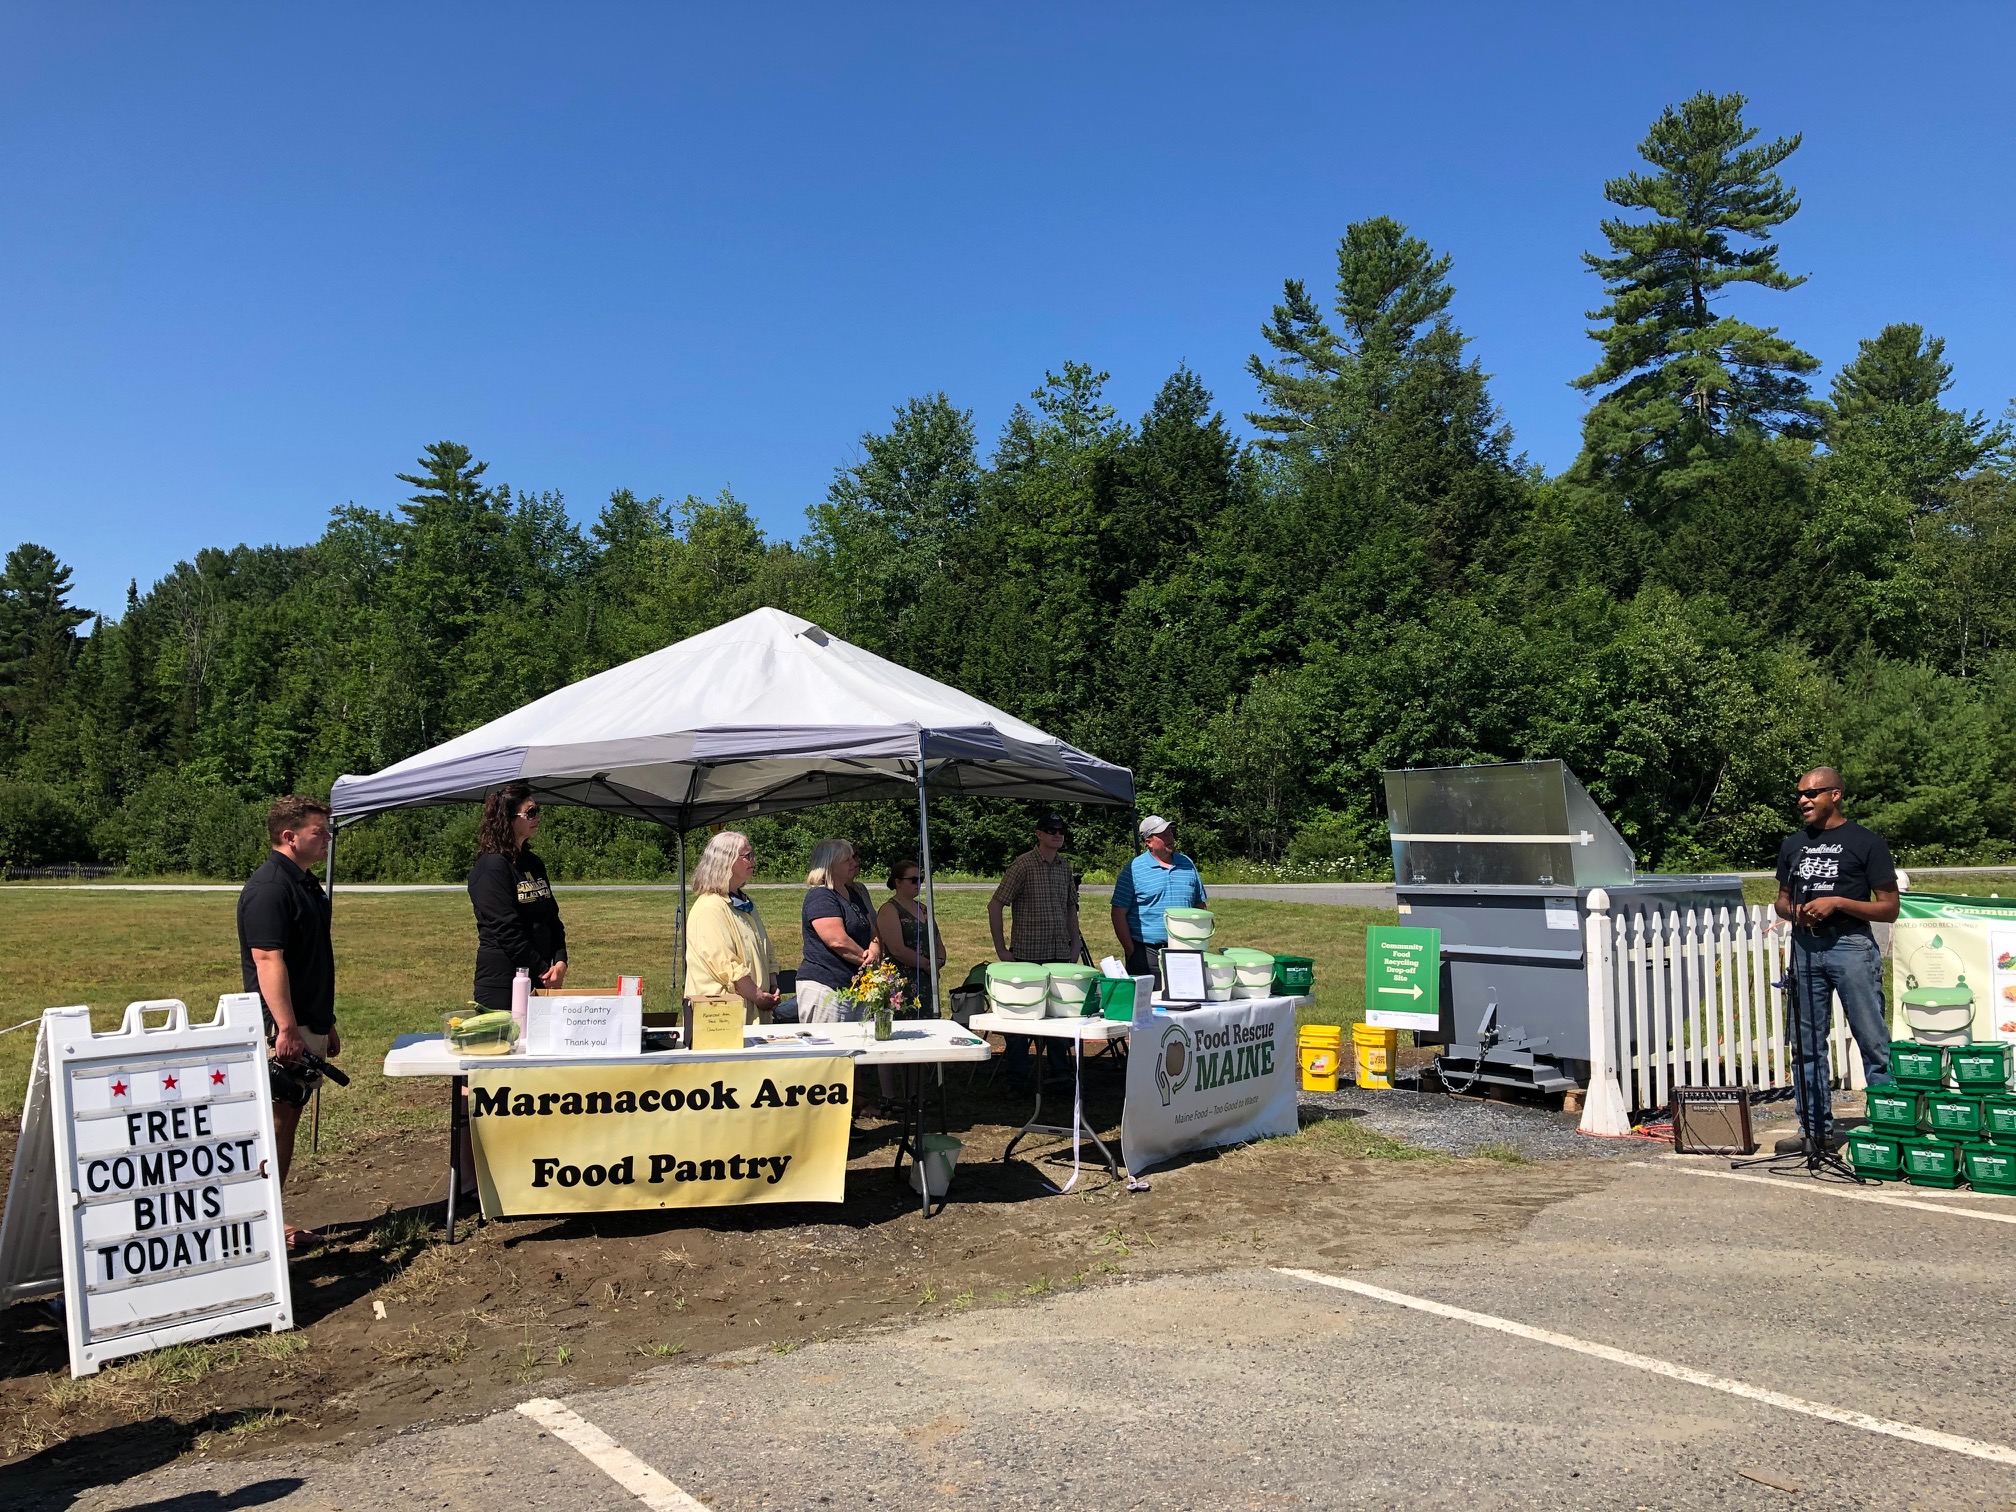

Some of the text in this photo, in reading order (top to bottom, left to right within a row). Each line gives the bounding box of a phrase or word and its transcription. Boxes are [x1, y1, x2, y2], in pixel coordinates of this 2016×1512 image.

[1813, 881, 1835, 891] Talent
[1381, 942, 1423, 951] Community
[1393, 950, 1411, 958] Food
[1384, 958, 1419, 967] Recycling
[1386, 966, 1417, 975] Drop-off
[1393, 974, 1408, 982] Site
[562, 1005, 611, 1015] Food Pantry
[566, 1018, 607, 1026] Donations
[564, 1038, 608, 1047] Thank you!
[1195, 1022, 1274, 1051] Food Rescue
[1195, 1040, 1275, 1092] MAINE
[472, 1078, 849, 1118] Maranacook Area
[1174, 1112, 1194, 1125] Maine
[1194, 1109, 1208, 1120] Food
[1213, 1105, 1223, 1115] Too
[1224, 1101, 1239, 1112] Good
[1239, 1099, 1244, 1108] to
[1244, 1096, 1259, 1106] Waste
[127, 1104, 211, 1146] FREE
[87, 1140, 254, 1192] COMPOST
[531, 1153, 792, 1188] Food Pantry
[134, 1186, 221, 1231] BINS
[98, 1222, 252, 1280] TODAY!!!
